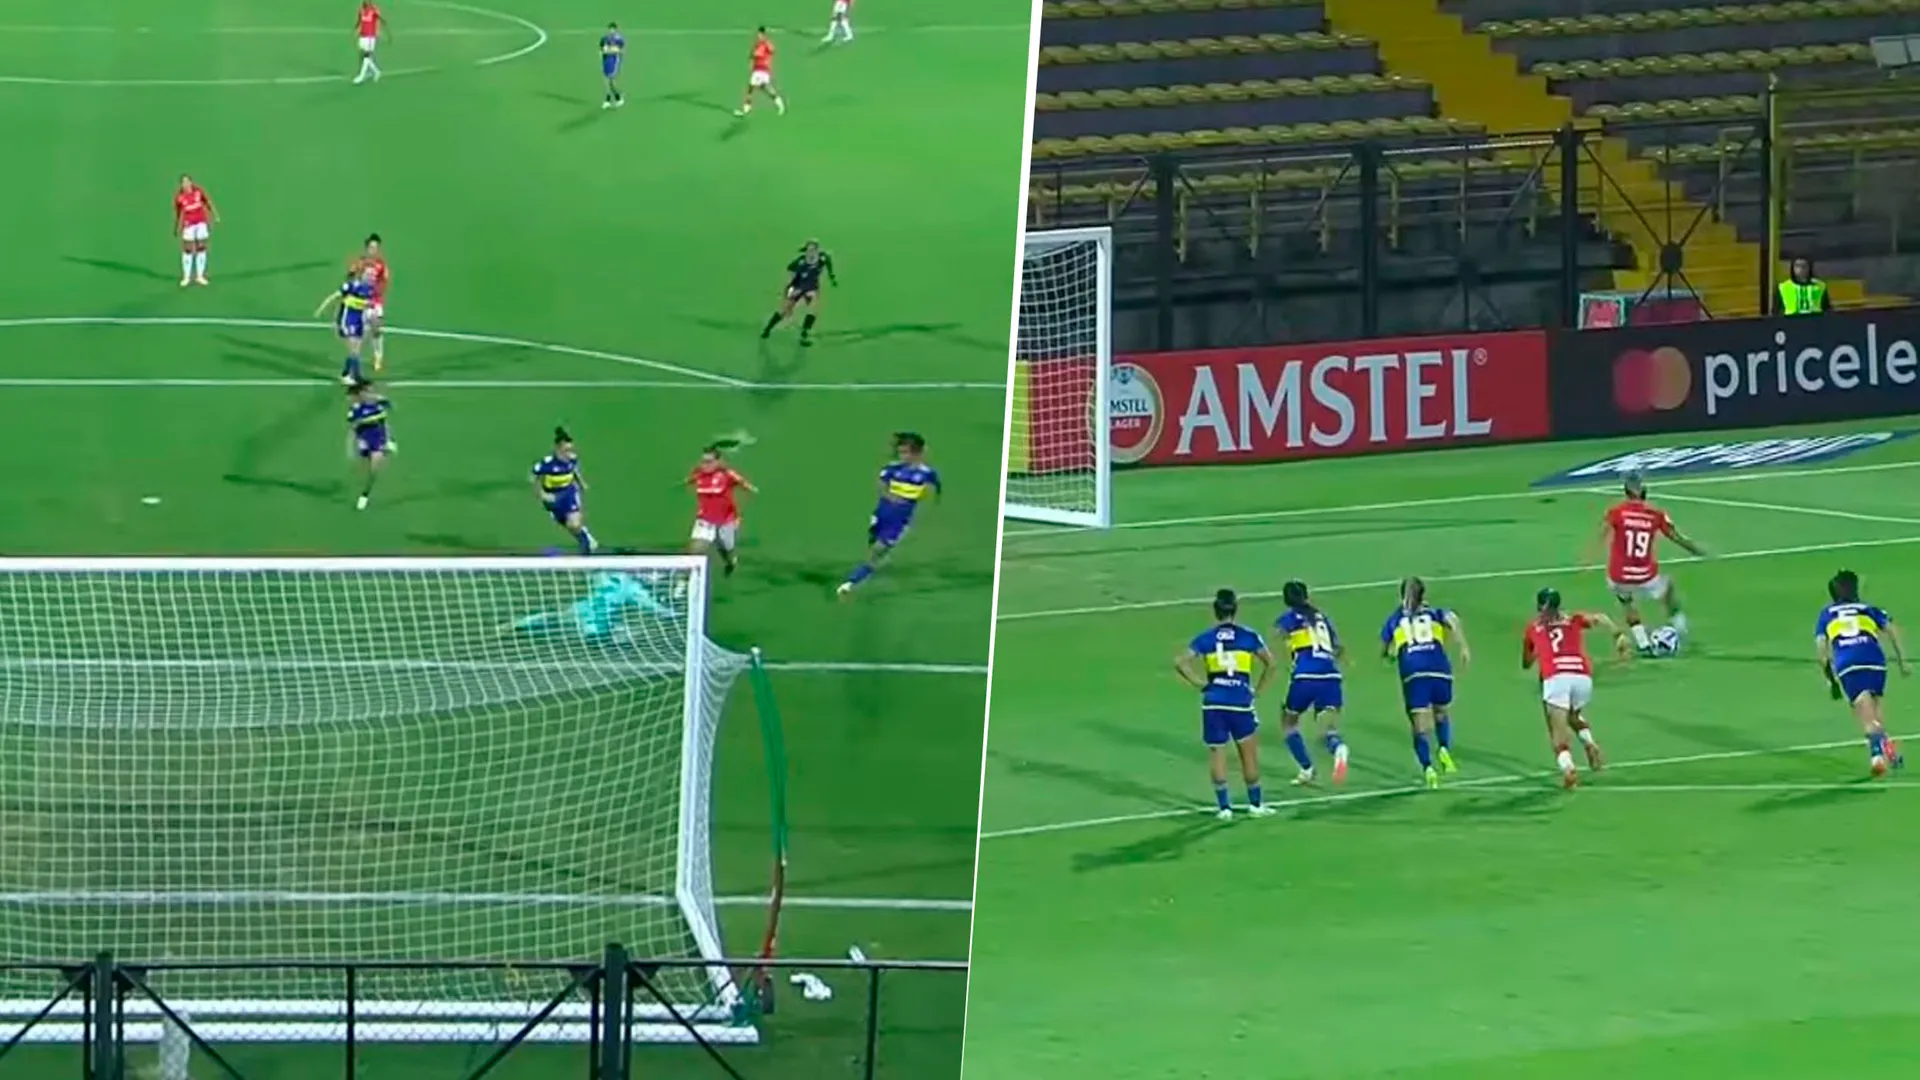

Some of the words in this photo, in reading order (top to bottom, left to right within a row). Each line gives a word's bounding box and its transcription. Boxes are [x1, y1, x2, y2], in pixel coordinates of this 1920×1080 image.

[1704, 323, 1918, 415] pricele
[1110, 398, 1149, 413] MSTEL
[1625, 529, 1651, 558] 19
[1215, 641, 1237, 677] 4
